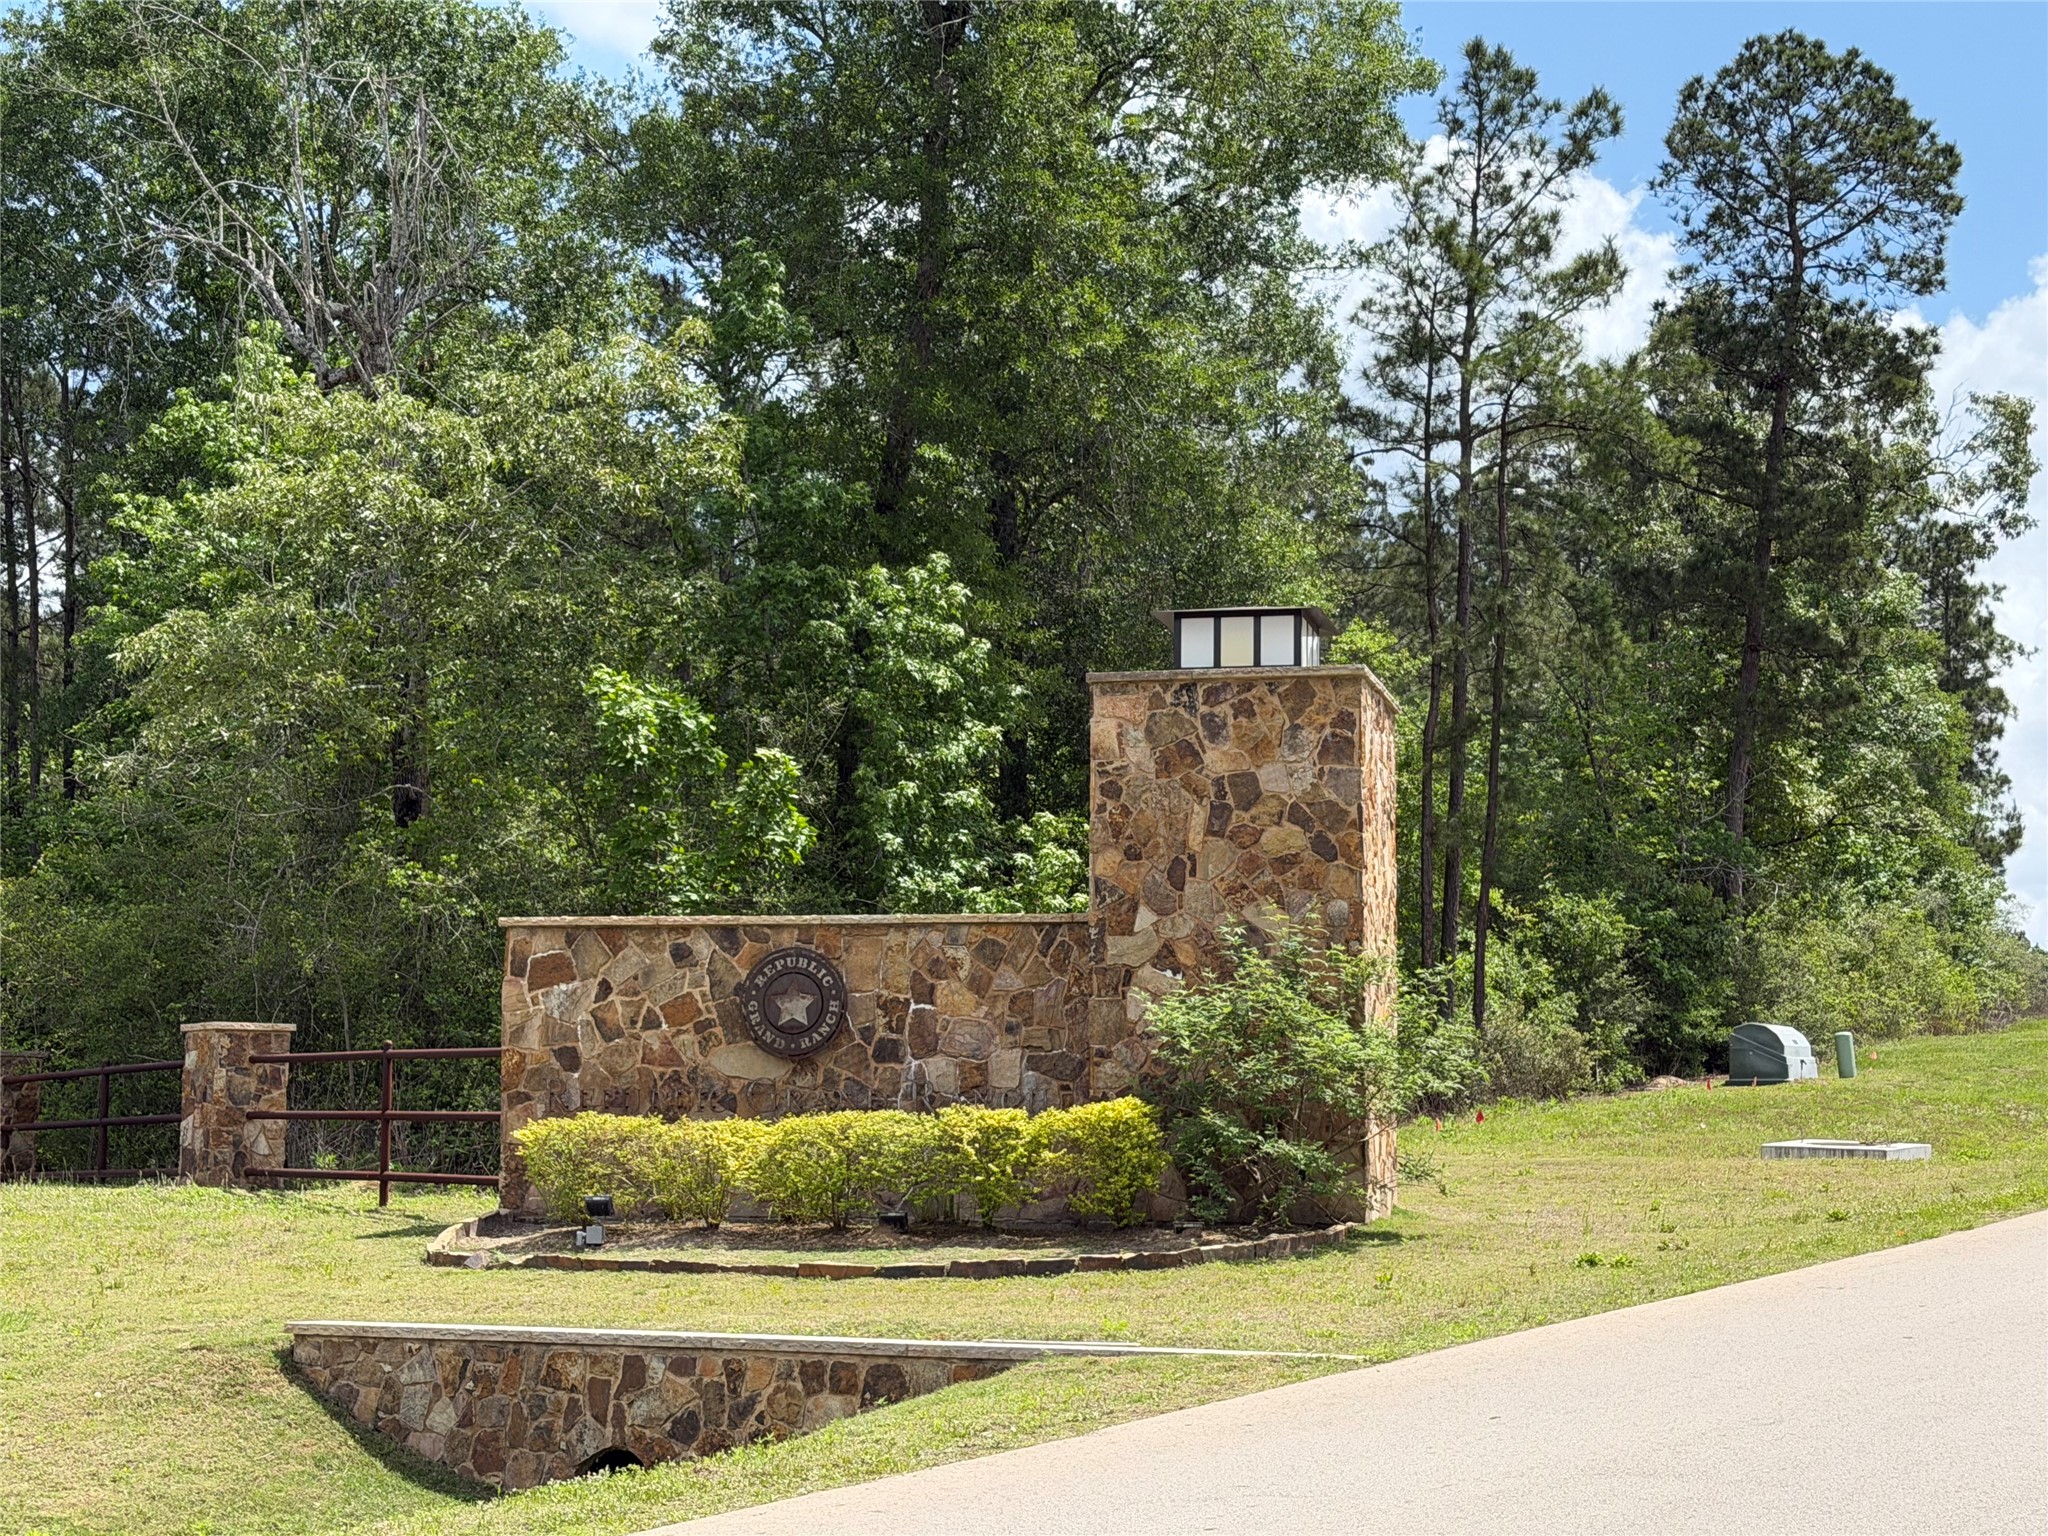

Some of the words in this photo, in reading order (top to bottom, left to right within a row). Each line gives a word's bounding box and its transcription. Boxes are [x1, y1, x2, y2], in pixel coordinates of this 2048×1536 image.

[754, 957, 833, 987] REPUBLIC
[748, 1000, 785, 1049] GRAND
[801, 1000, 839, 1049] RANCH
